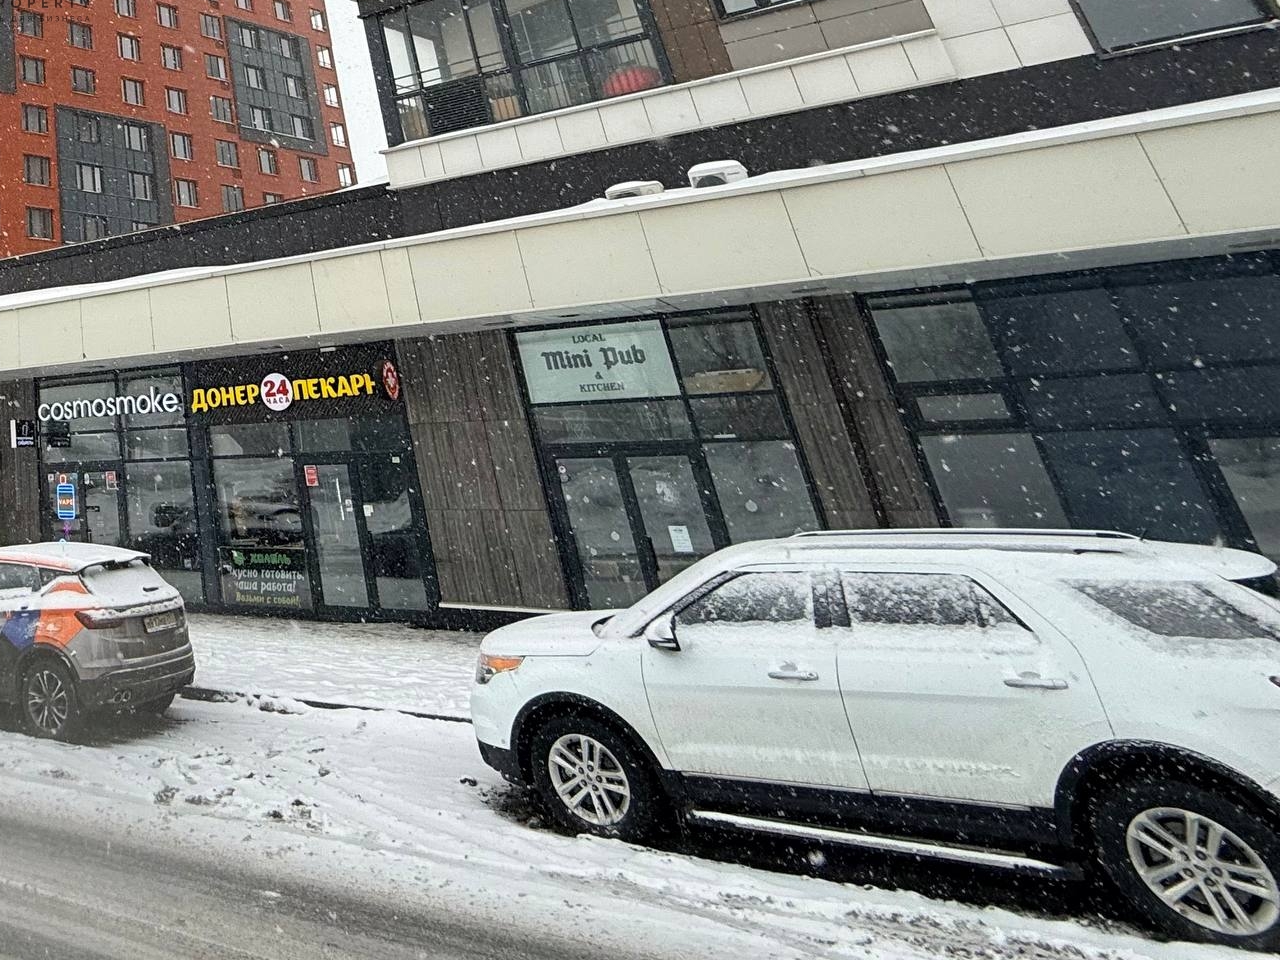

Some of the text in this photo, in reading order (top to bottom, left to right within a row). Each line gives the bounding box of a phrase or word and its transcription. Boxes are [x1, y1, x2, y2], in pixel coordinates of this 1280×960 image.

[572, 333, 606, 344] LOCAL
[540, 344, 646, 371] Mini Pub
[594, 371, 604, 380] &
[579, 382, 625, 393] KITCHEN
[191, 383, 259, 414] ДОНЕР
[263, 378, 289, 398] 24
[266, 396, 291, 405] ЧАСА
[37, 385, 179, 422] cosmosmoke
